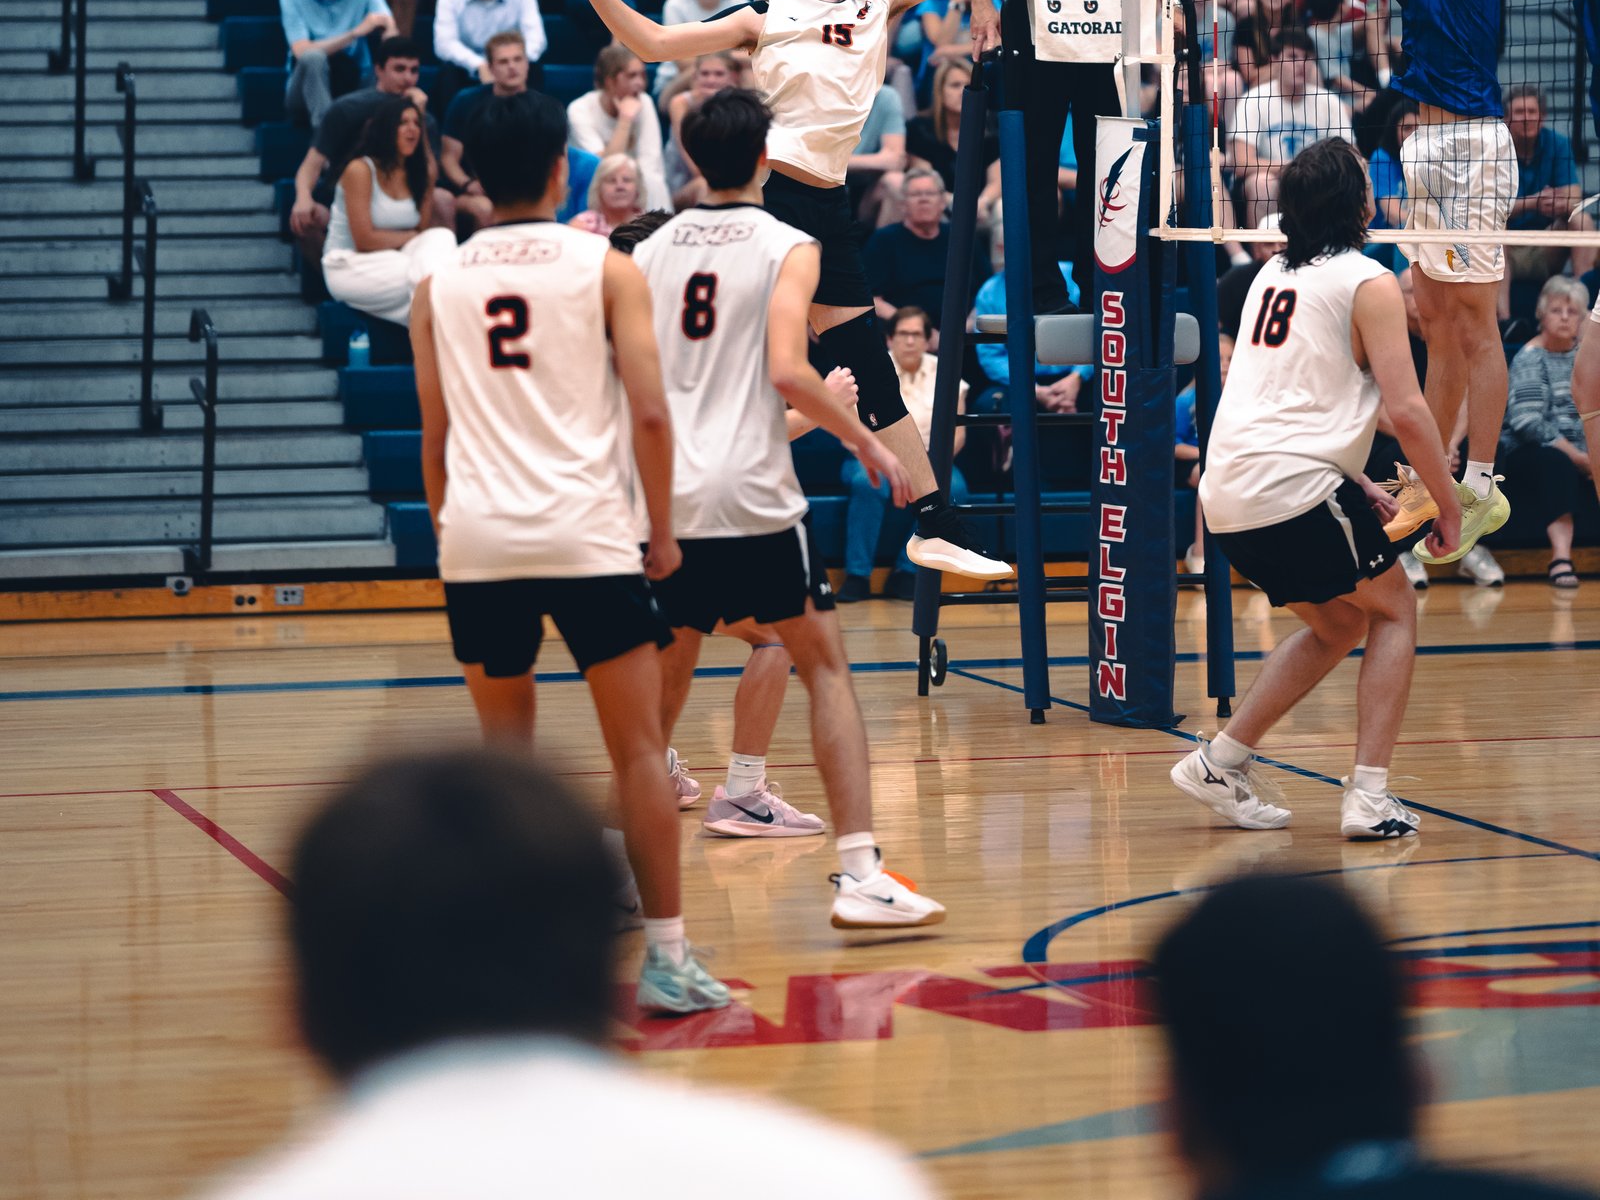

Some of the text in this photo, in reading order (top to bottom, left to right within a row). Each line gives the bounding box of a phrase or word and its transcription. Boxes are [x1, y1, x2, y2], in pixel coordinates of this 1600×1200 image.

[822, 23, 856, 48] 15
[485, 295, 531, 370] 2
[681, 271, 718, 341] 8
[1251, 286, 1297, 349] 18
[1096, 290, 1128, 701] SOUTH ELGIN
